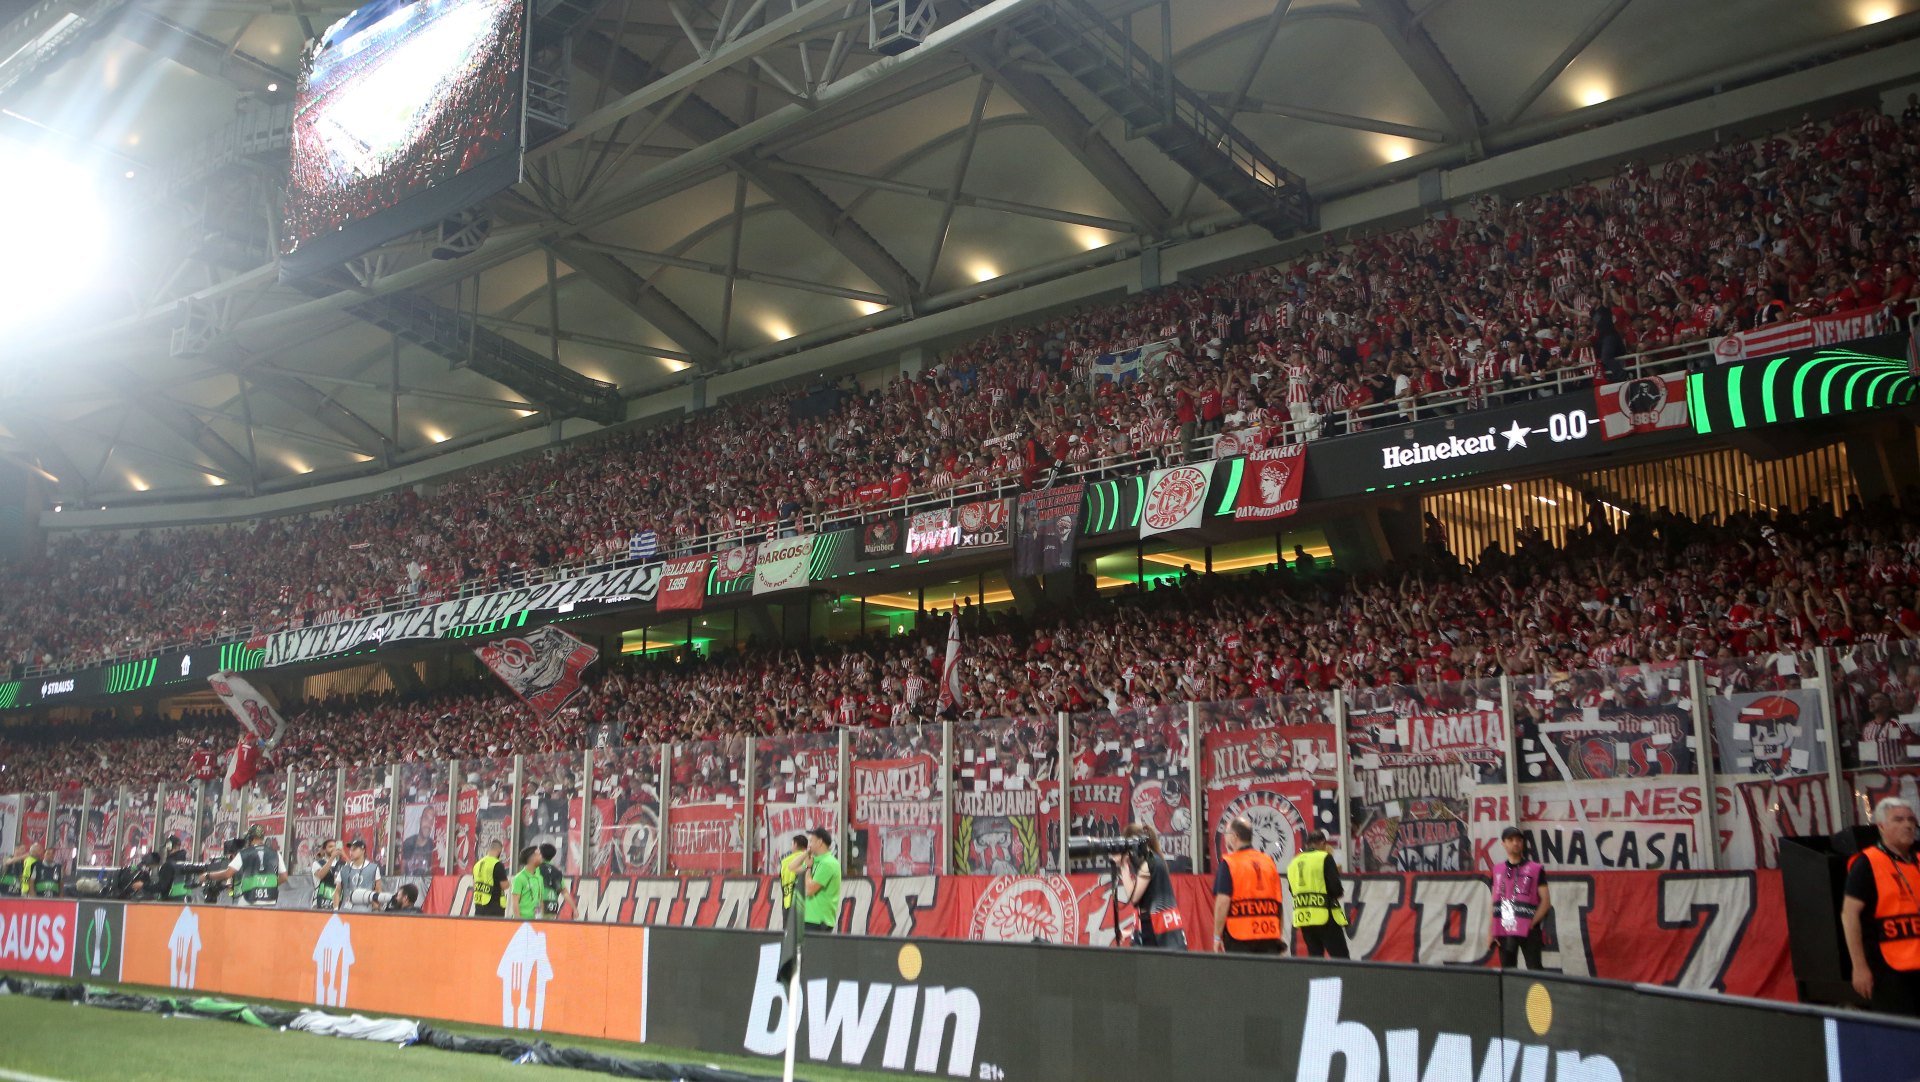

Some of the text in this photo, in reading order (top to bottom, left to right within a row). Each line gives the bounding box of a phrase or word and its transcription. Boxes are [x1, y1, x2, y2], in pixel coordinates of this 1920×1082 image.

[1382, 434, 1495, 469] Heineken
[764, 544, 803, 564] ARGOS
[47, 679, 75, 695] STRAUSS
[1252, 921, 1277, 935] 205
[744, 942, 981, 1077] bwin
